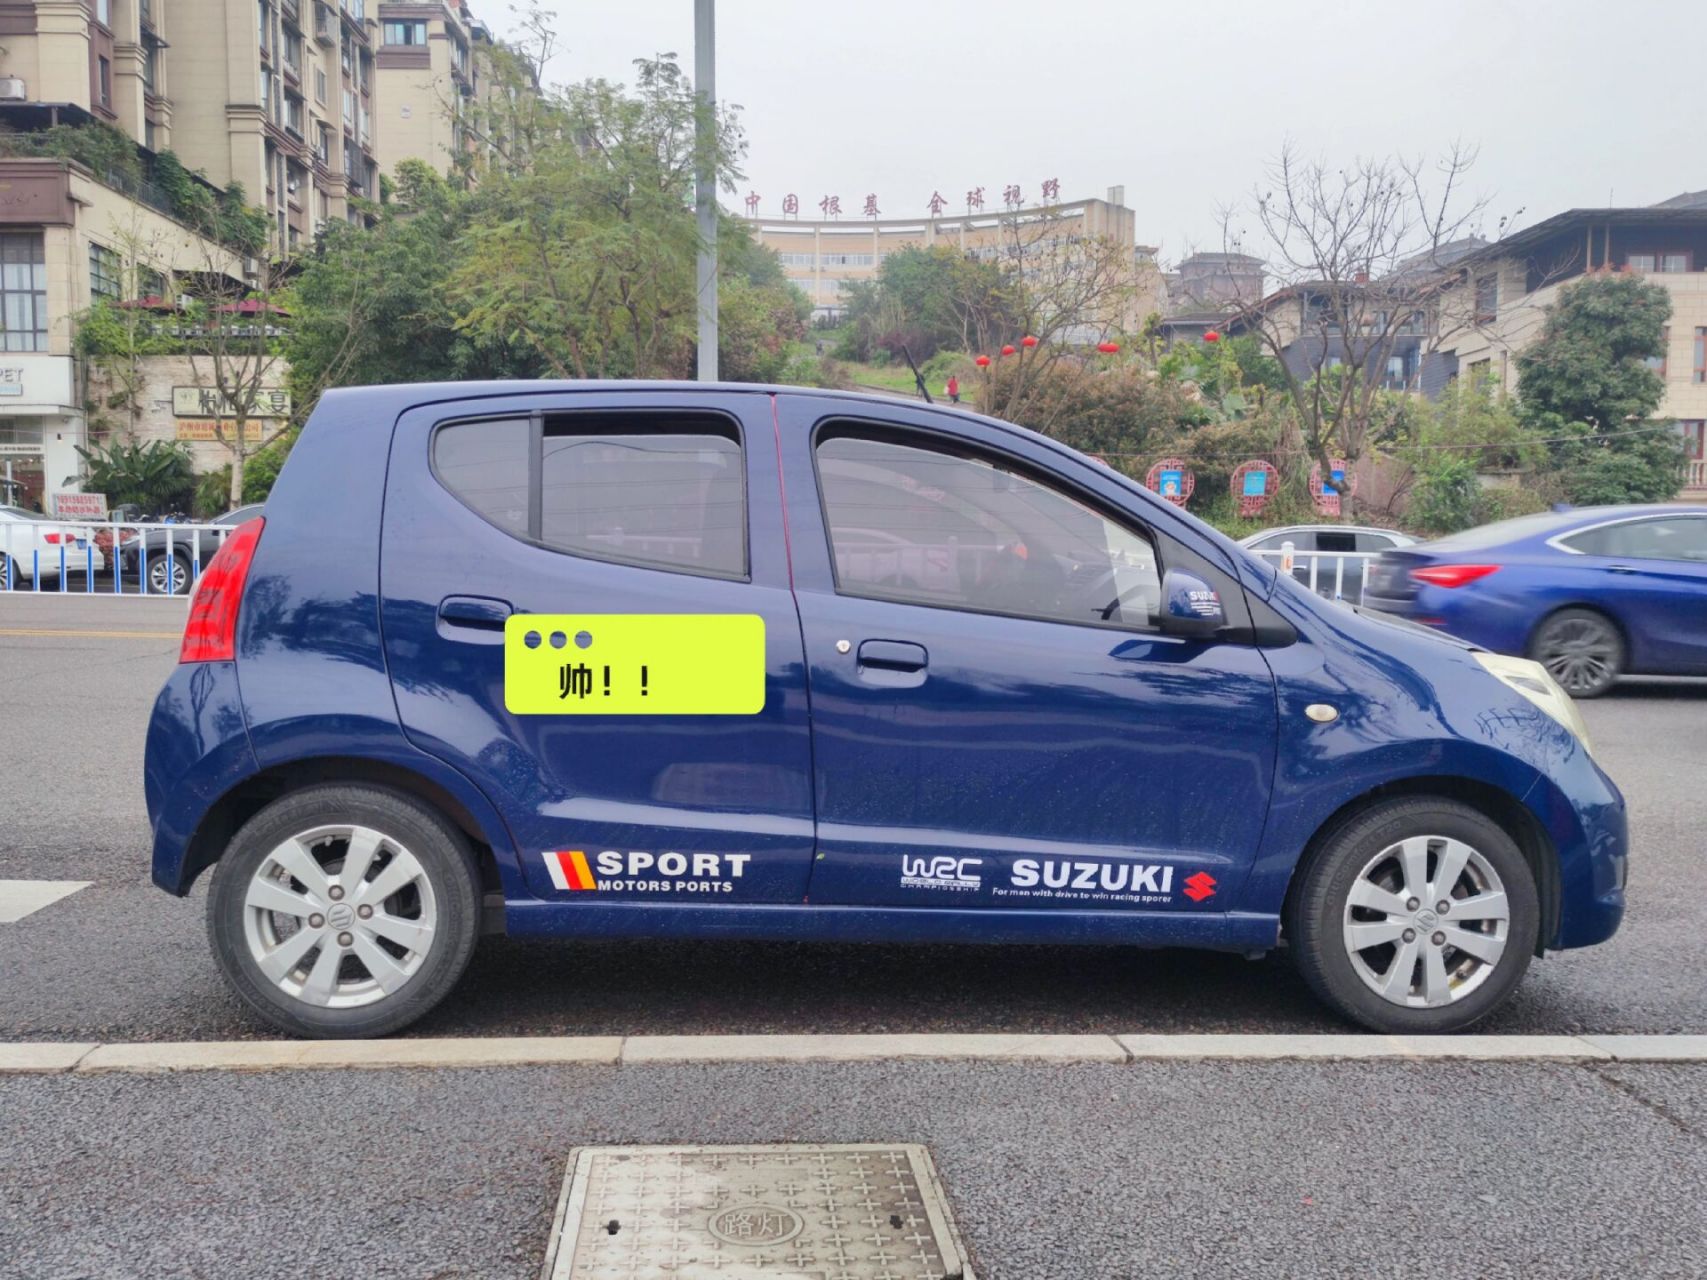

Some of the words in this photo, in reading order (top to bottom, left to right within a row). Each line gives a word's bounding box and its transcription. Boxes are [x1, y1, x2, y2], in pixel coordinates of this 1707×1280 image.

[745, 191, 881, 216] 中国根基
[927, 178, 1061, 213] 全球视野
[597, 851, 751, 877] SPORT
[902, 854, 983, 880] WRC
[1011, 859, 1173, 892] SUZUKI
[597, 880, 671, 892] MOTORS
[675, 881, 733, 893] PORTS
[992, 887, 1008, 896] For
[1032, 889, 1053, 898] with
[1055, 891, 1078, 899] drive
[1111, 894, 1140, 902] racing
[725, 1213, 787, 1237] 路灯
